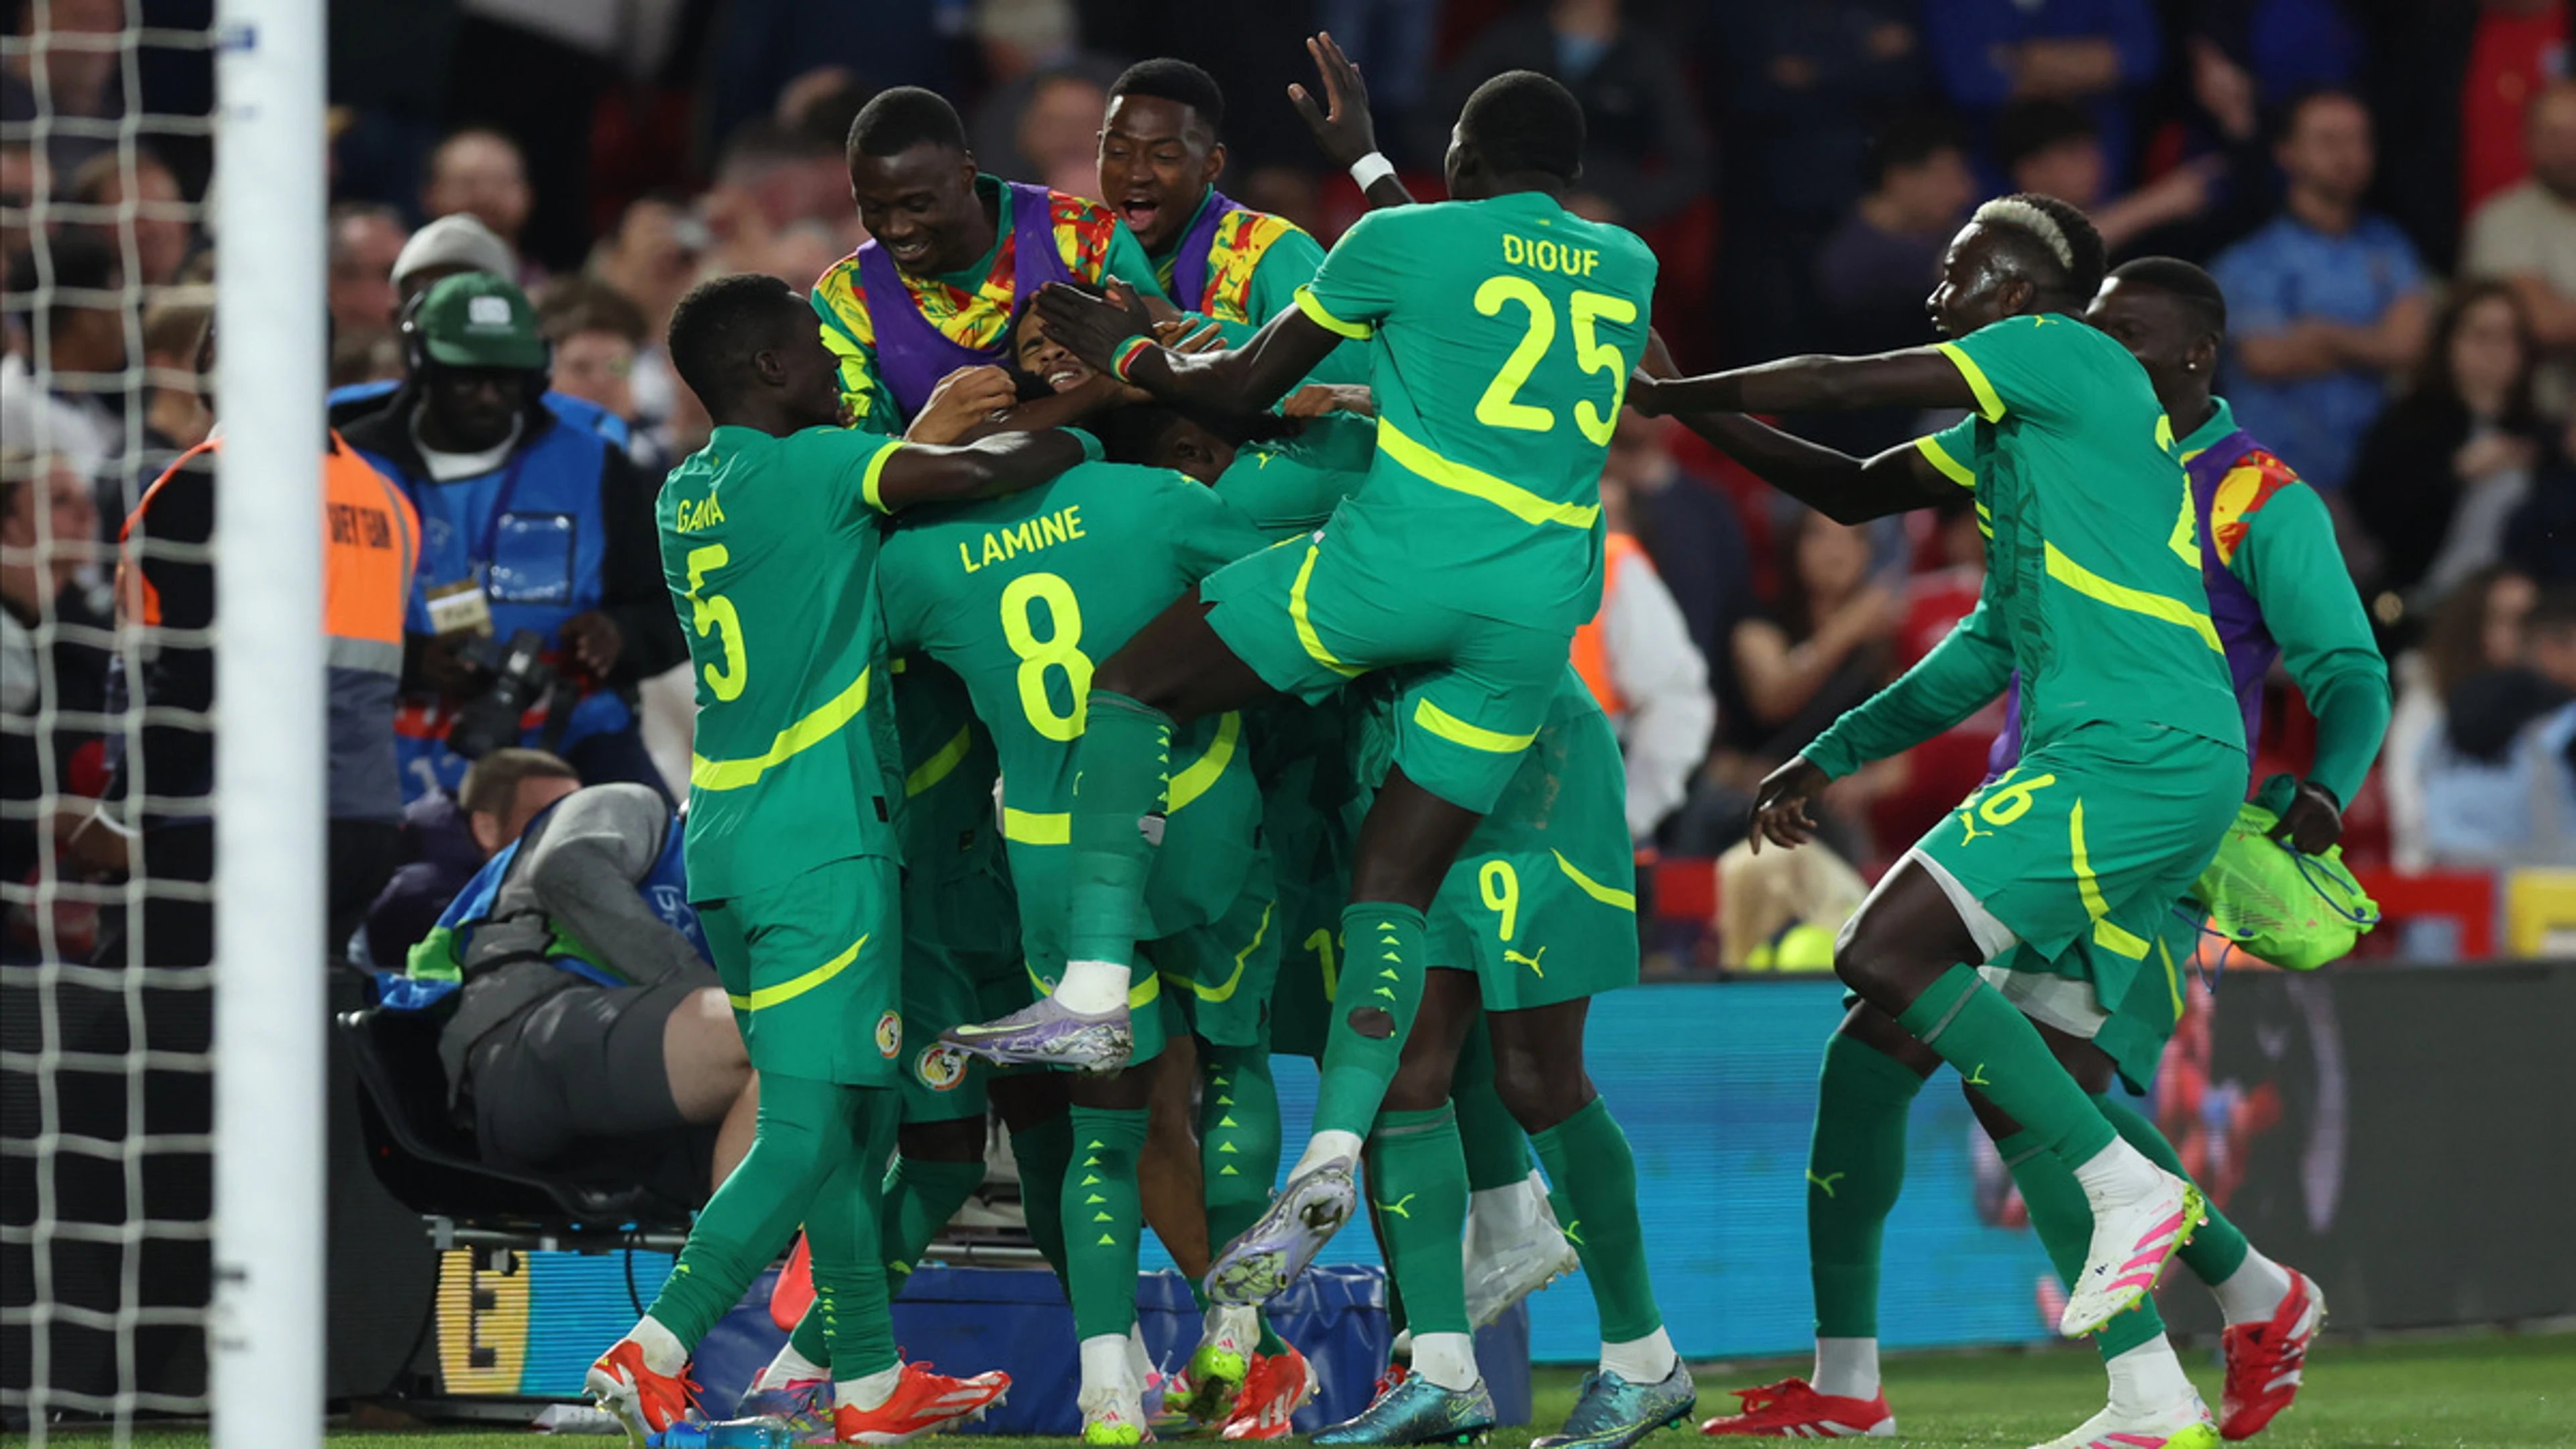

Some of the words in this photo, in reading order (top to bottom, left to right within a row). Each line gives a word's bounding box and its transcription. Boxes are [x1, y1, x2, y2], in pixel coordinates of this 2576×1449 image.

[1503, 234, 1599, 276] DIOUF
[1474, 275, 1637, 447] 25
[959, 504, 1086, 573] LAMINE
[684, 543, 748, 701] 5
[1000, 572, 1095, 742] 8
[1479, 859, 1519, 941] 9
[1303, 927, 1346, 1003] 1
